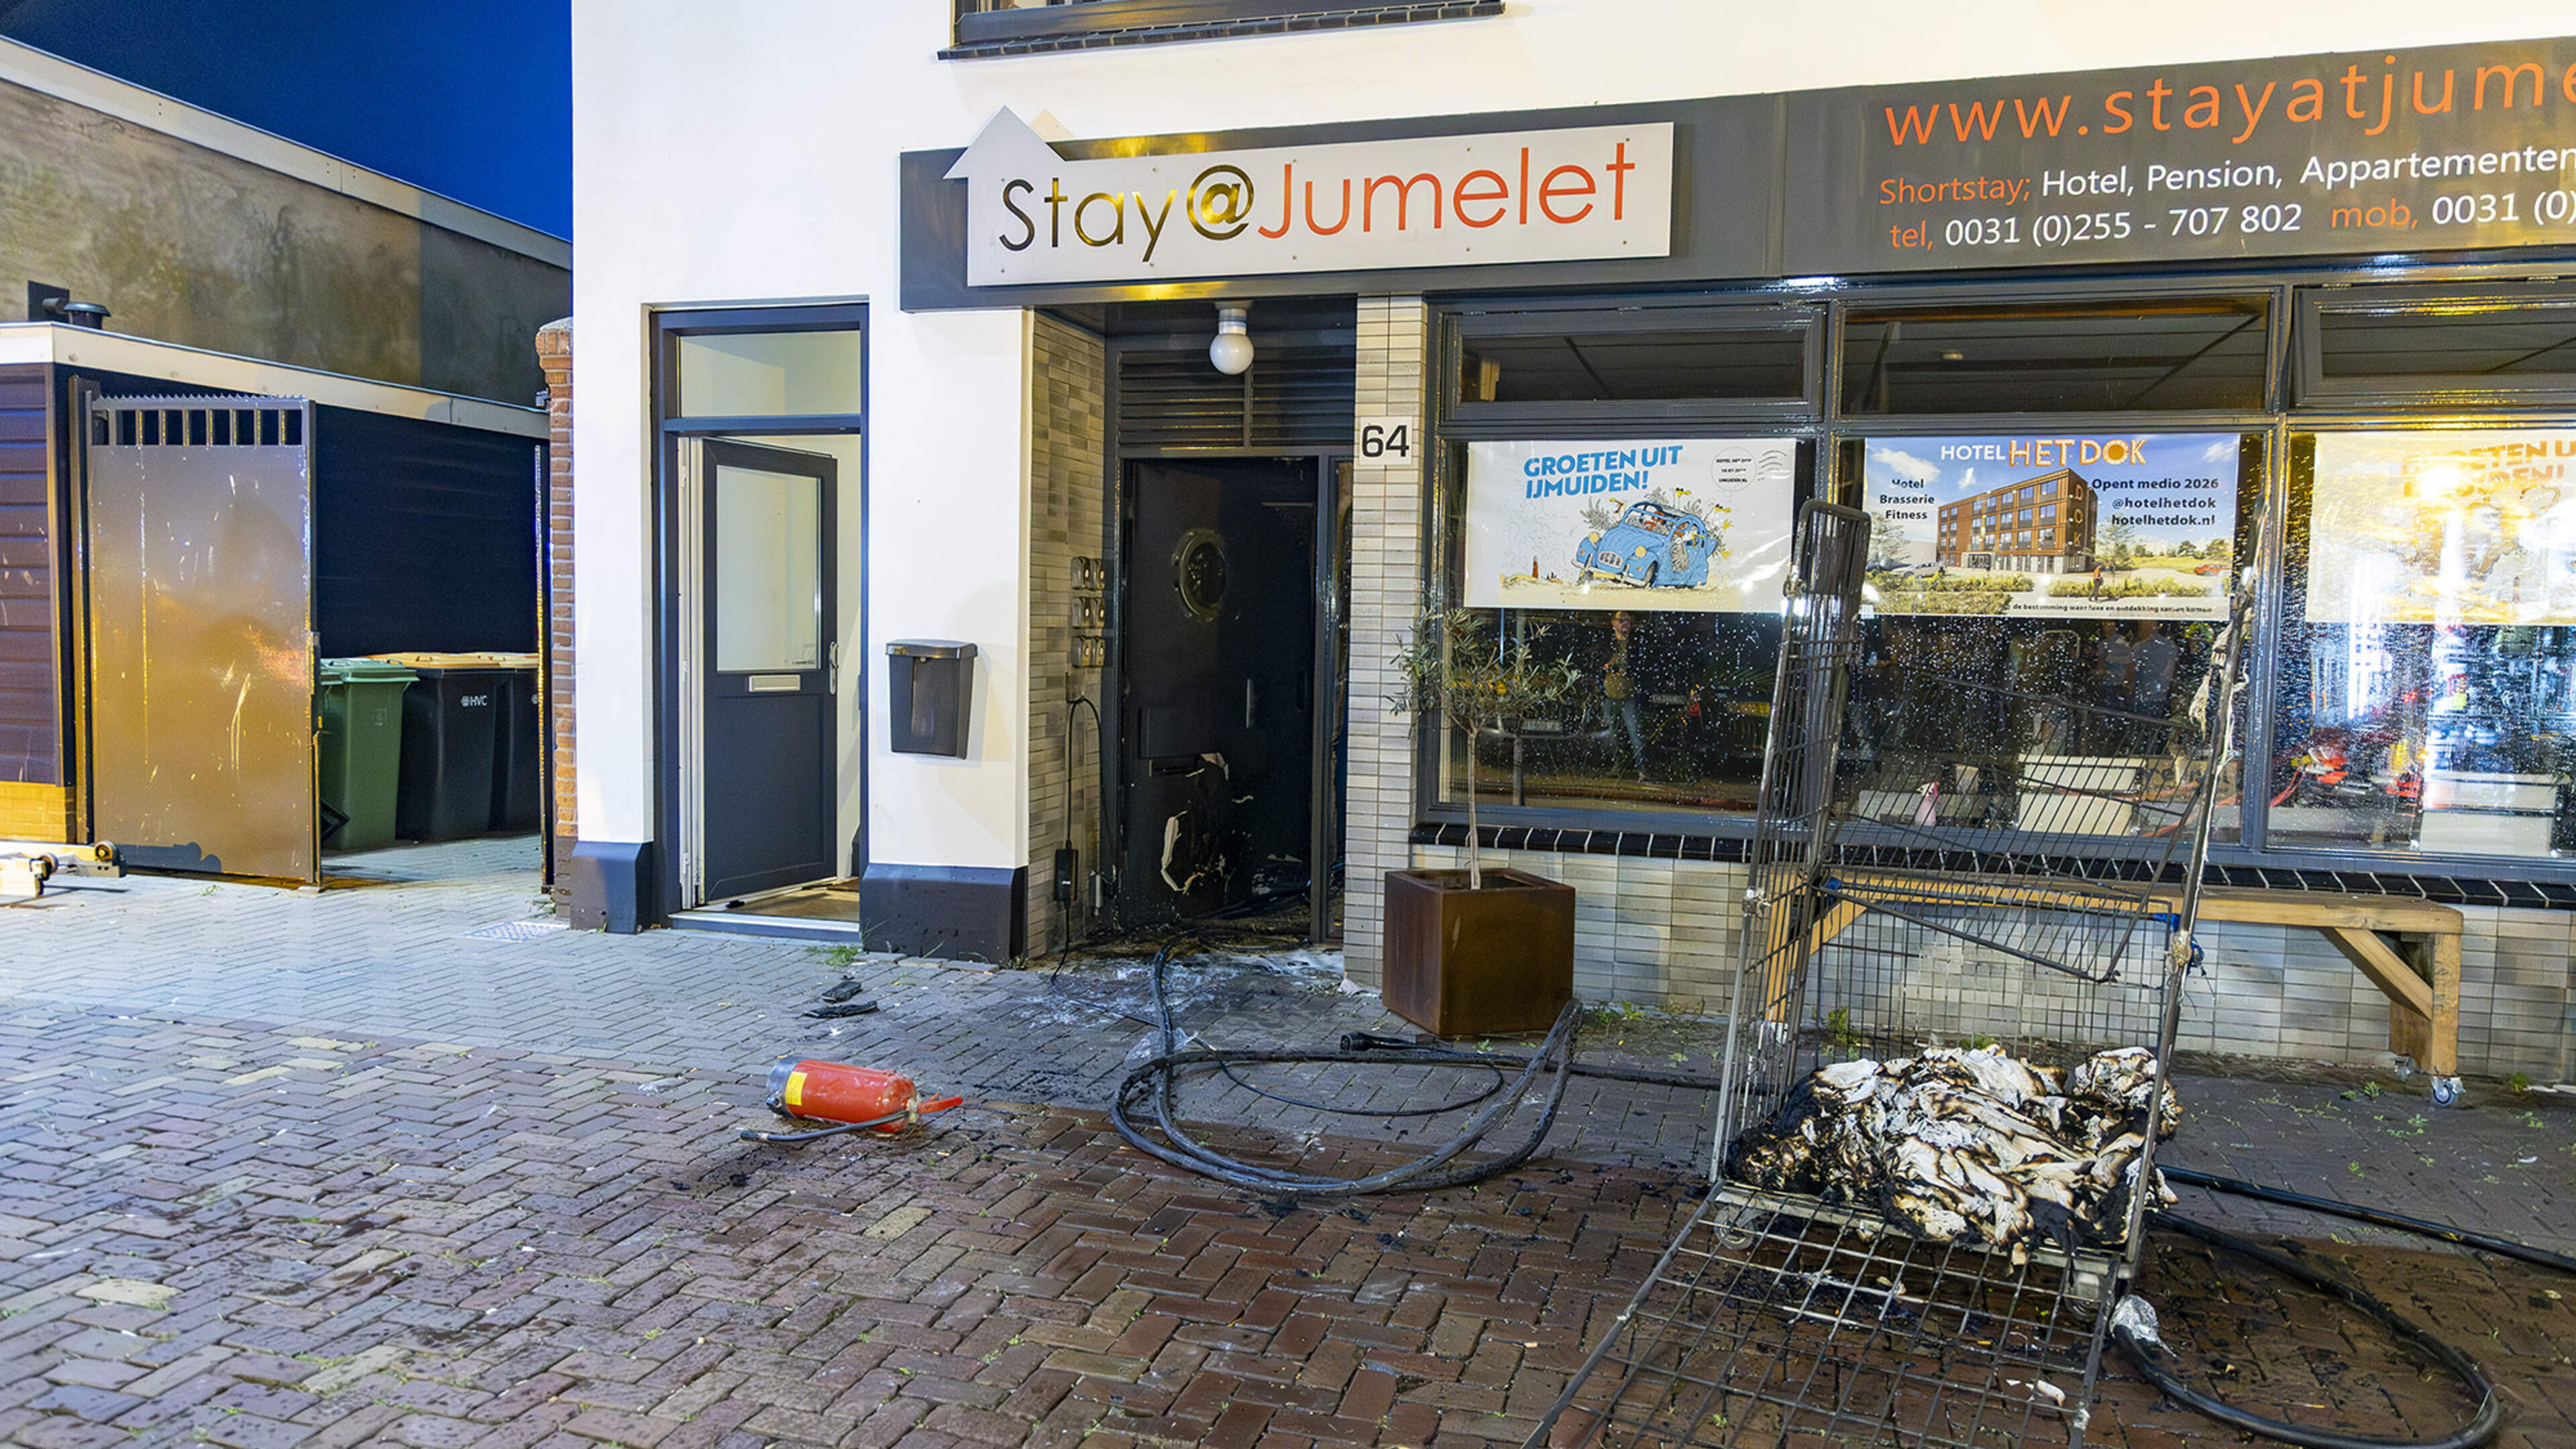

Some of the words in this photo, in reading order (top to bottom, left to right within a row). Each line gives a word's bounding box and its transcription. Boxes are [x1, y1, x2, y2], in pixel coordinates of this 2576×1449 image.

[1880, 176, 2030, 206] Shortstay;
[2043, 164, 2134, 197] Hotel,
[2147, 159, 2282, 191] Pension,
[2300, 145, 2576, 191] Appartementen
[999, 142, 1635, 262] Stay@Jumelet
[1889, 219, 1933, 250] tel,
[1945, 217, 2021, 246] 0031
[2033, 211, 2131, 247] (0)255
[2169, 207, 2229, 236] 707
[2240, 203, 2302, 233] 802
[2331, 199, 2418, 229] mob,
[2432, 193, 2520, 225] 0031
[1362, 425, 1409, 457] 64
[1941, 445, 2006, 460] HOTEL
[2009, 439, 2076, 467] HET
[2079, 439, 2147, 466] DOK
[1523, 449, 1636, 477] GROETEN
[1642, 445, 1683, 467] UIT
[1525, 470, 1648, 499] IJMUIDEN!
[1892, 479, 1924, 488] Hotel
[2092, 478, 2134, 491] Opent
[2138, 478, 2181, 489] medio
[2184, 478, 2219, 489] 2026
[1880, 494, 1935, 504] Brasserie
[2112, 497, 2216, 509] @hotelhetdok
[1886, 510, 1927, 519] Fitness
[2112, 515, 2215, 525] hotelhetdok.nl
